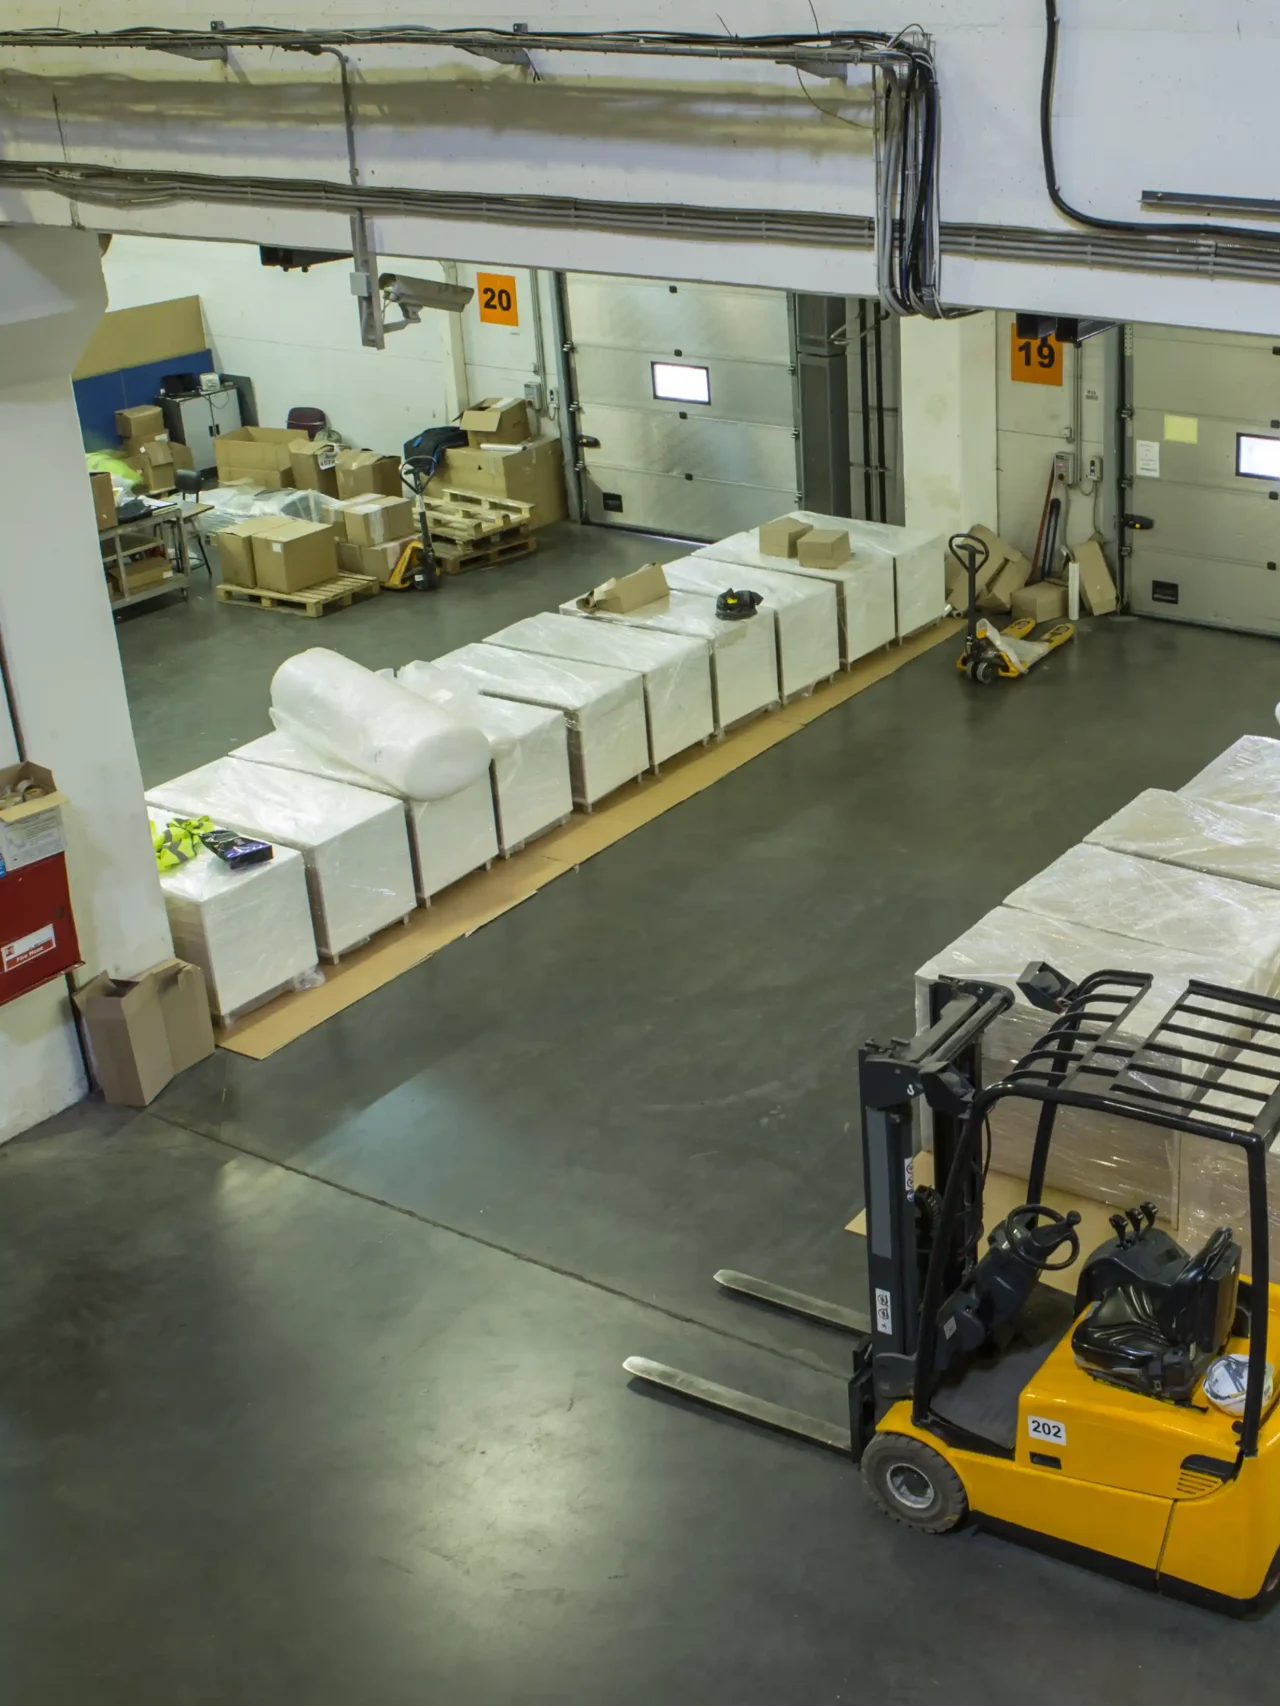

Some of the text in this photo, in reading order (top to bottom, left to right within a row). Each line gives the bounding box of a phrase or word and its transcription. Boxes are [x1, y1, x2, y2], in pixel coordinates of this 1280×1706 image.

[483, 287, 511, 311] 20
[1018, 341, 1055, 368] 19
[1031, 1420, 1062, 1439] 202
